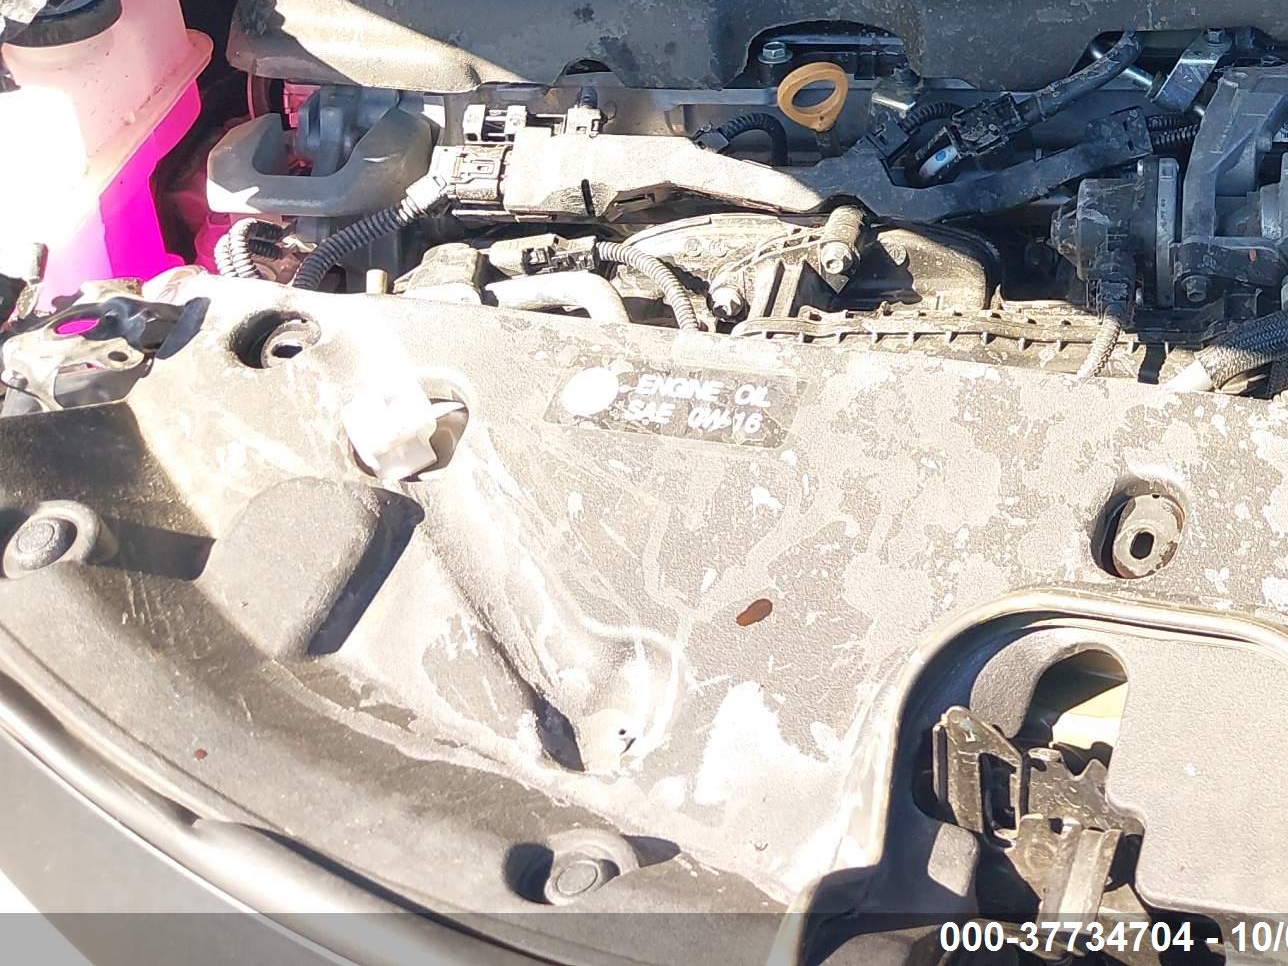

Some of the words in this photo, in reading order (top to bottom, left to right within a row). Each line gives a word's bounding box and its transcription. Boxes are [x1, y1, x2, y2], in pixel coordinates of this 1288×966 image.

[634, 373, 725, 402] ENGINE
[734, 384, 771, 408] OIL
[622, 399, 675, 425] SAE
